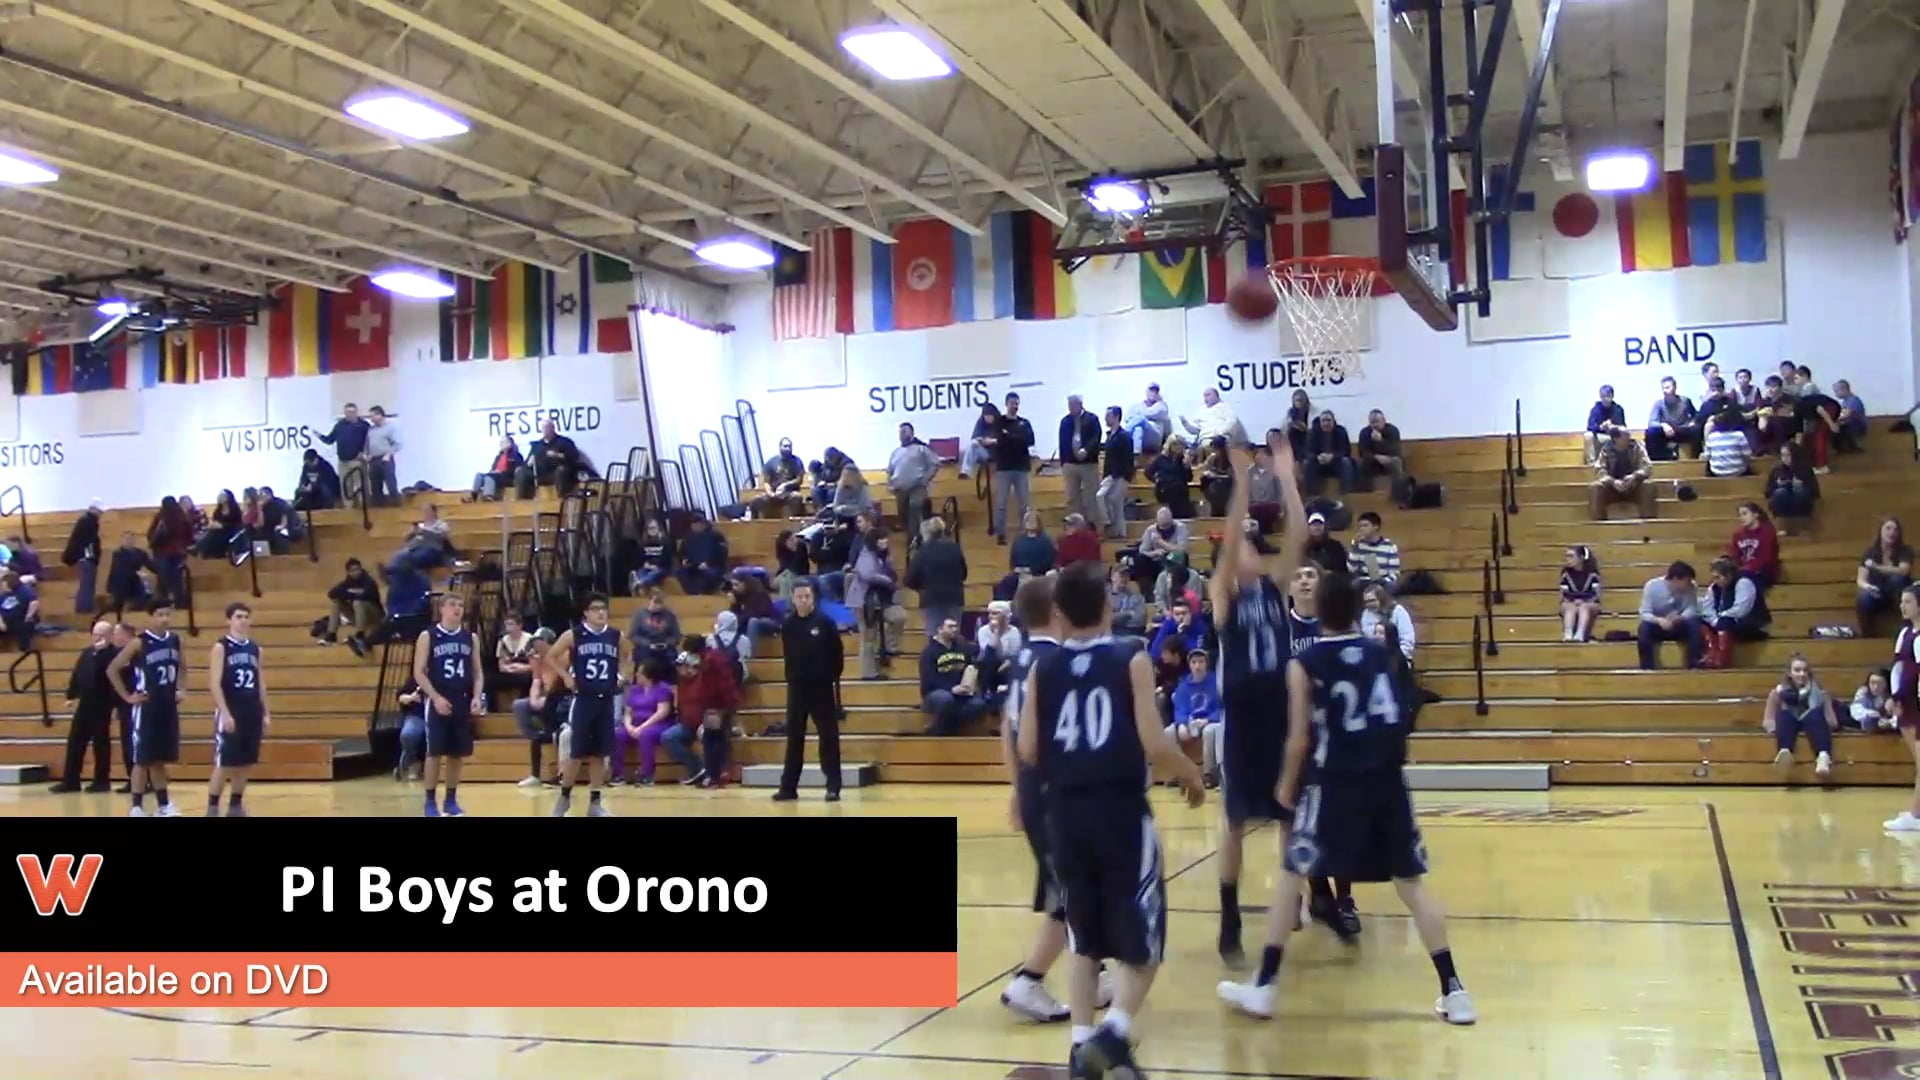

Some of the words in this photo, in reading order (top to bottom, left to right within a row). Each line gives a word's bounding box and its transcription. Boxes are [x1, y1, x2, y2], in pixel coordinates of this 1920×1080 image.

[1624, 332, 1715, 366] BAND
[868, 380, 989, 413] STUDENTS
[488, 405, 601, 437] RESERVED
[221, 425, 312, 454] VISITORS
[0, 441, 65, 468] SITORS
[157, 665, 177, 685] 20
[234, 668, 255, 688] 32
[443, 658, 465, 679] 54
[585, 658, 609, 680] 52
[1329, 672, 1400, 732] 24
[1053, 686, 1113, 753] 40
